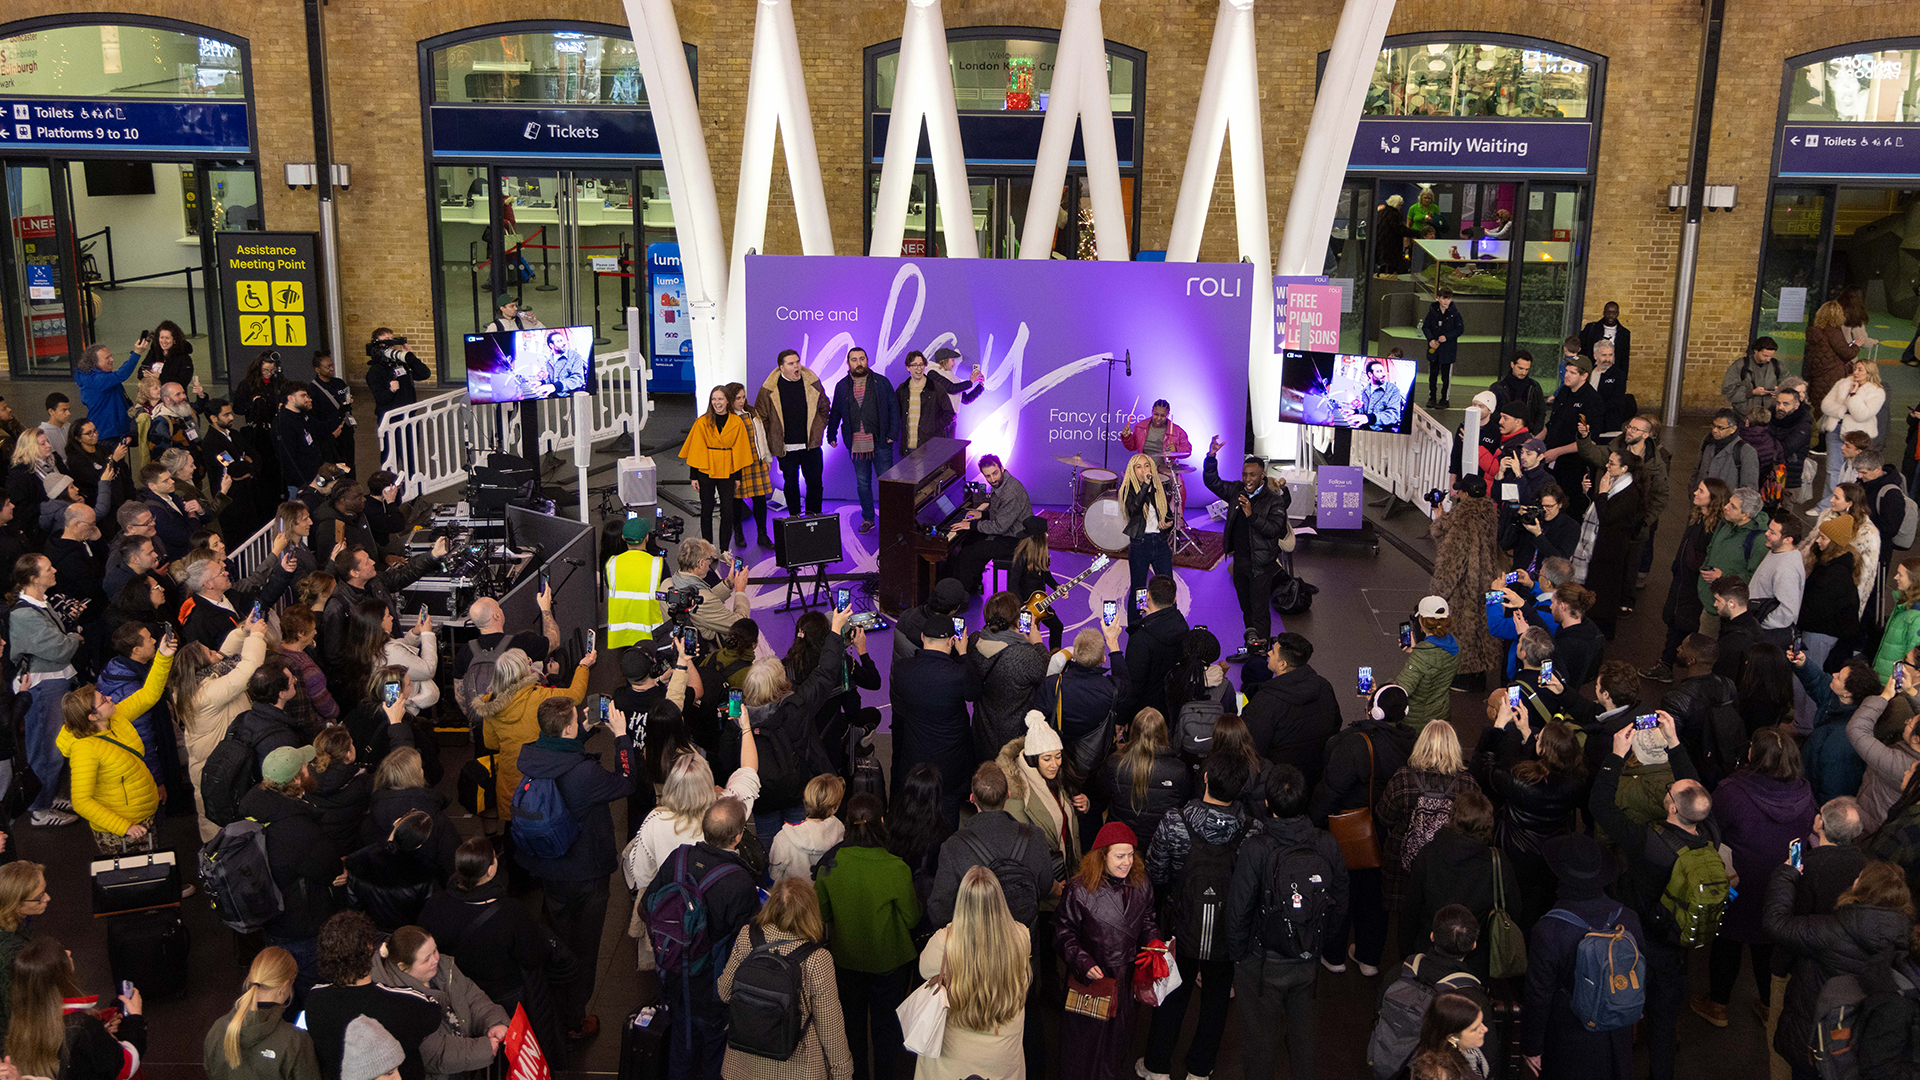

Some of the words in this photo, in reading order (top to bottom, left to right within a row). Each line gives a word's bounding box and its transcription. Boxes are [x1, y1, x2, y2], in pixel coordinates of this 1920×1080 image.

[1, 60, 38, 76] Edinburgh
[959, 61, 1000, 71] London
[34, 106, 75, 119] Toilets
[36, 126, 94, 139] Platforms
[95, 127, 105, 139] 9
[106, 128, 121, 139] to
[123, 128, 140, 140] 10
[547, 124, 600, 139] Tickets
[1410, 137, 1463, 156] Family
[1466, 137, 1529, 157] Waiting
[1823, 136, 1857, 147] Toilets
[22, 218, 56, 231] LNER
[236, 244, 297, 256] Assistance
[901, 243, 925, 255] NER
[229, 258, 276, 272] Meeting
[277, 259, 307, 270] Point
[654, 252, 681, 266] lum
[656, 276, 680, 286] lumo
[1289, 292, 1318, 309] FREE
[776, 305, 825, 321] Come
[827, 306, 859, 322] and
[1288, 311, 1323, 327] PIANO
[1288, 328, 1337, 346] LESONS
[1049, 408, 1097, 427] Fancy
[1100, 412, 1111, 424] a
[1115, 409, 1147, 424] free
[1048, 426, 1094, 443] piano
